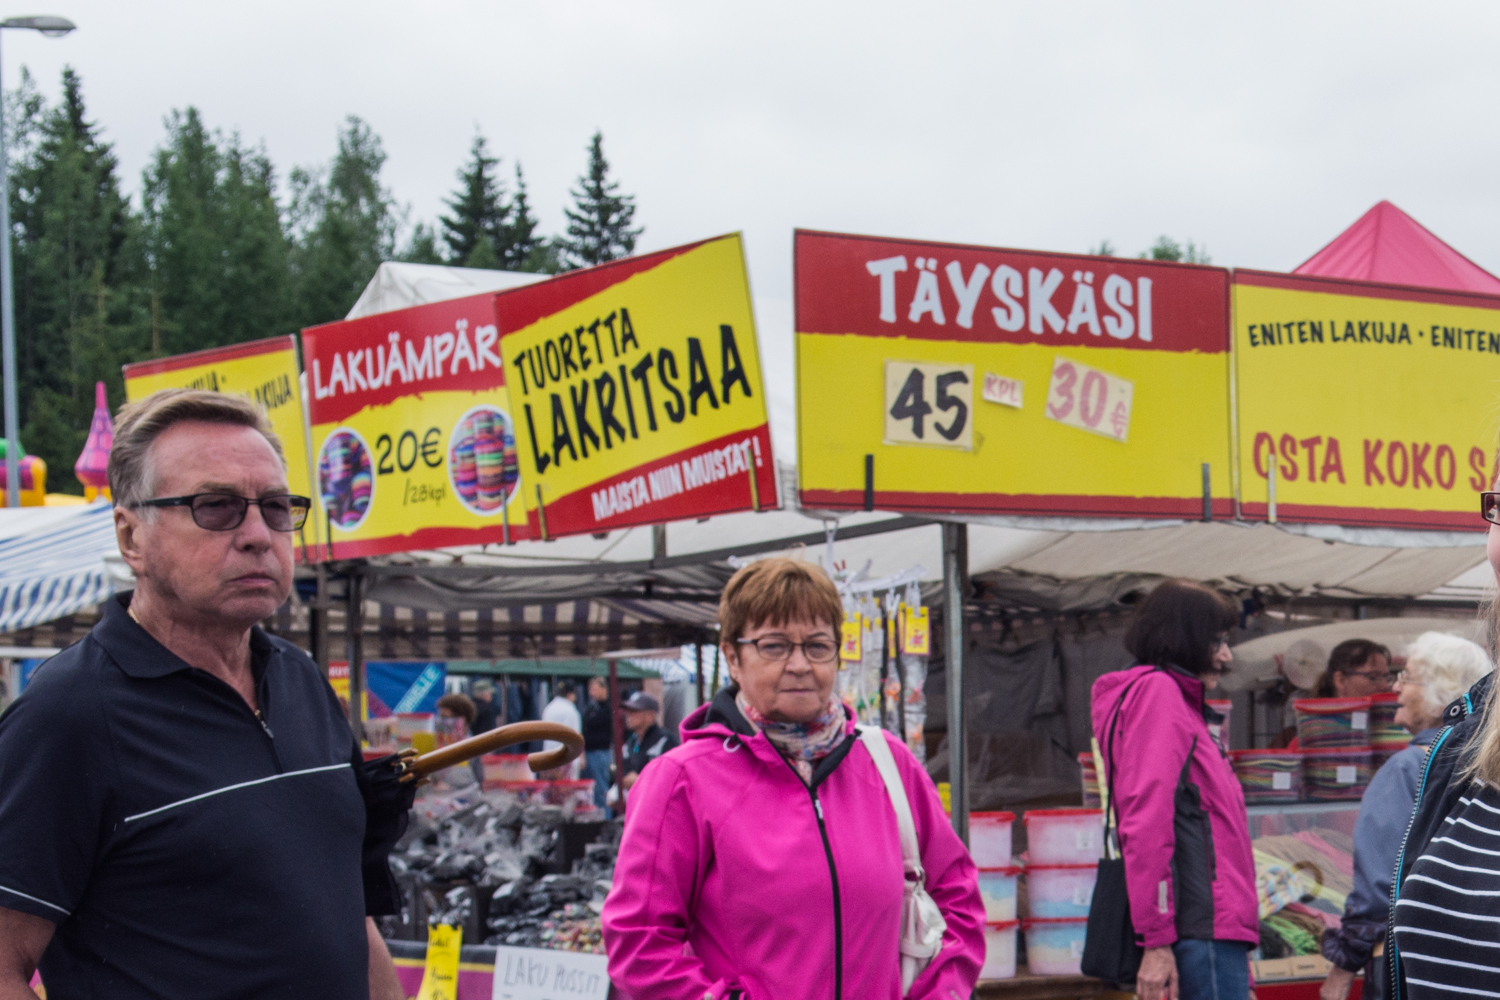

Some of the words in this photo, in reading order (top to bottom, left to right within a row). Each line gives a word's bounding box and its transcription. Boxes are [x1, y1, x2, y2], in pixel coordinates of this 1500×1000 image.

[866, 255, 1153, 342] TÄYSKÄSI
[513, 308, 639, 396] TUORETTA
[1248, 320, 1325, 347] ENITEN
[1330, 320, 1412, 346] LAKUJA
[1431, 325, 1500, 355] ENITEN
[524, 324, 753, 475] LAKRITSAA
[889, 368, 970, 442] 45
[984, 376, 1020, 403] KPL
[591, 474, 650, 521] MAISTA
[648, 464, 684, 502] NIIN
[1253, 432, 1346, 485] OSTA
[1363, 438, 1457, 491] KOKO
[503, 953, 549, 987] LAKU
